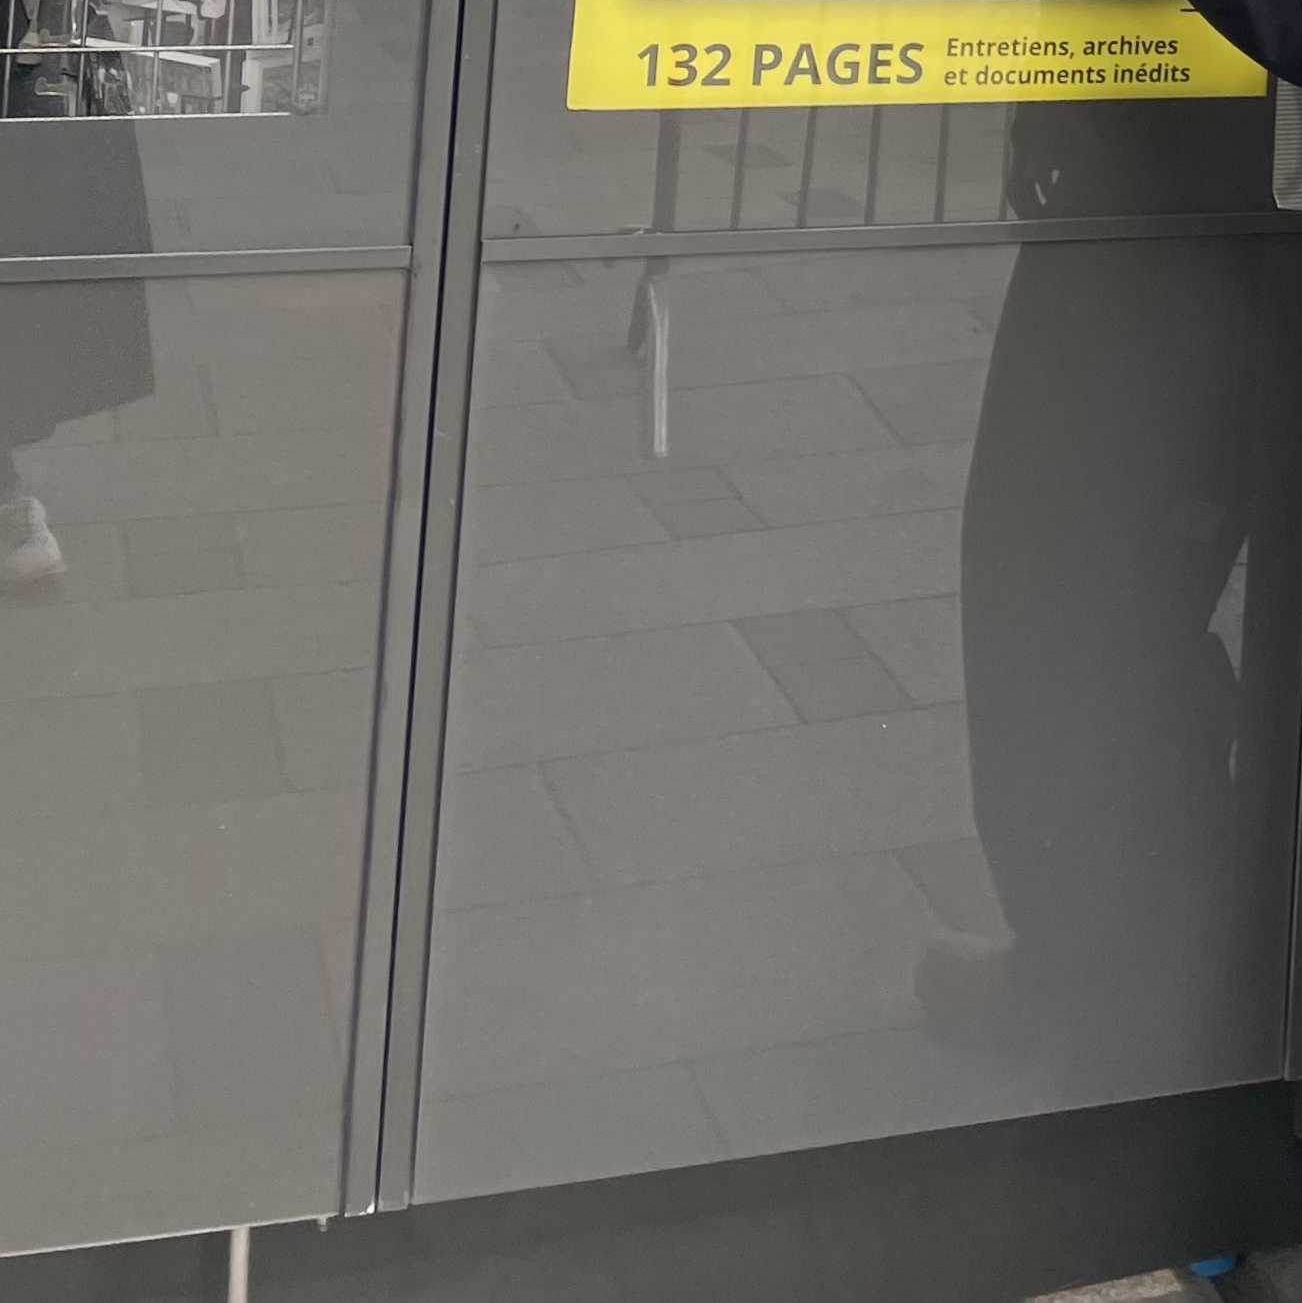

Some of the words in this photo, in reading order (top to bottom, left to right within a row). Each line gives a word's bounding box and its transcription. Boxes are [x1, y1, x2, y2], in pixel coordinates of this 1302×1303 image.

[946, 37, 1076, 59] Entretiens,
[1082, 35, 1179, 56] archives
[637, 42, 733, 87] 132
[751, 42, 926, 86] PAGES
[943, 68, 969, 86] et
[974, 65, 1107, 86] documents
[1112, 62, 1191, 84] inédits
